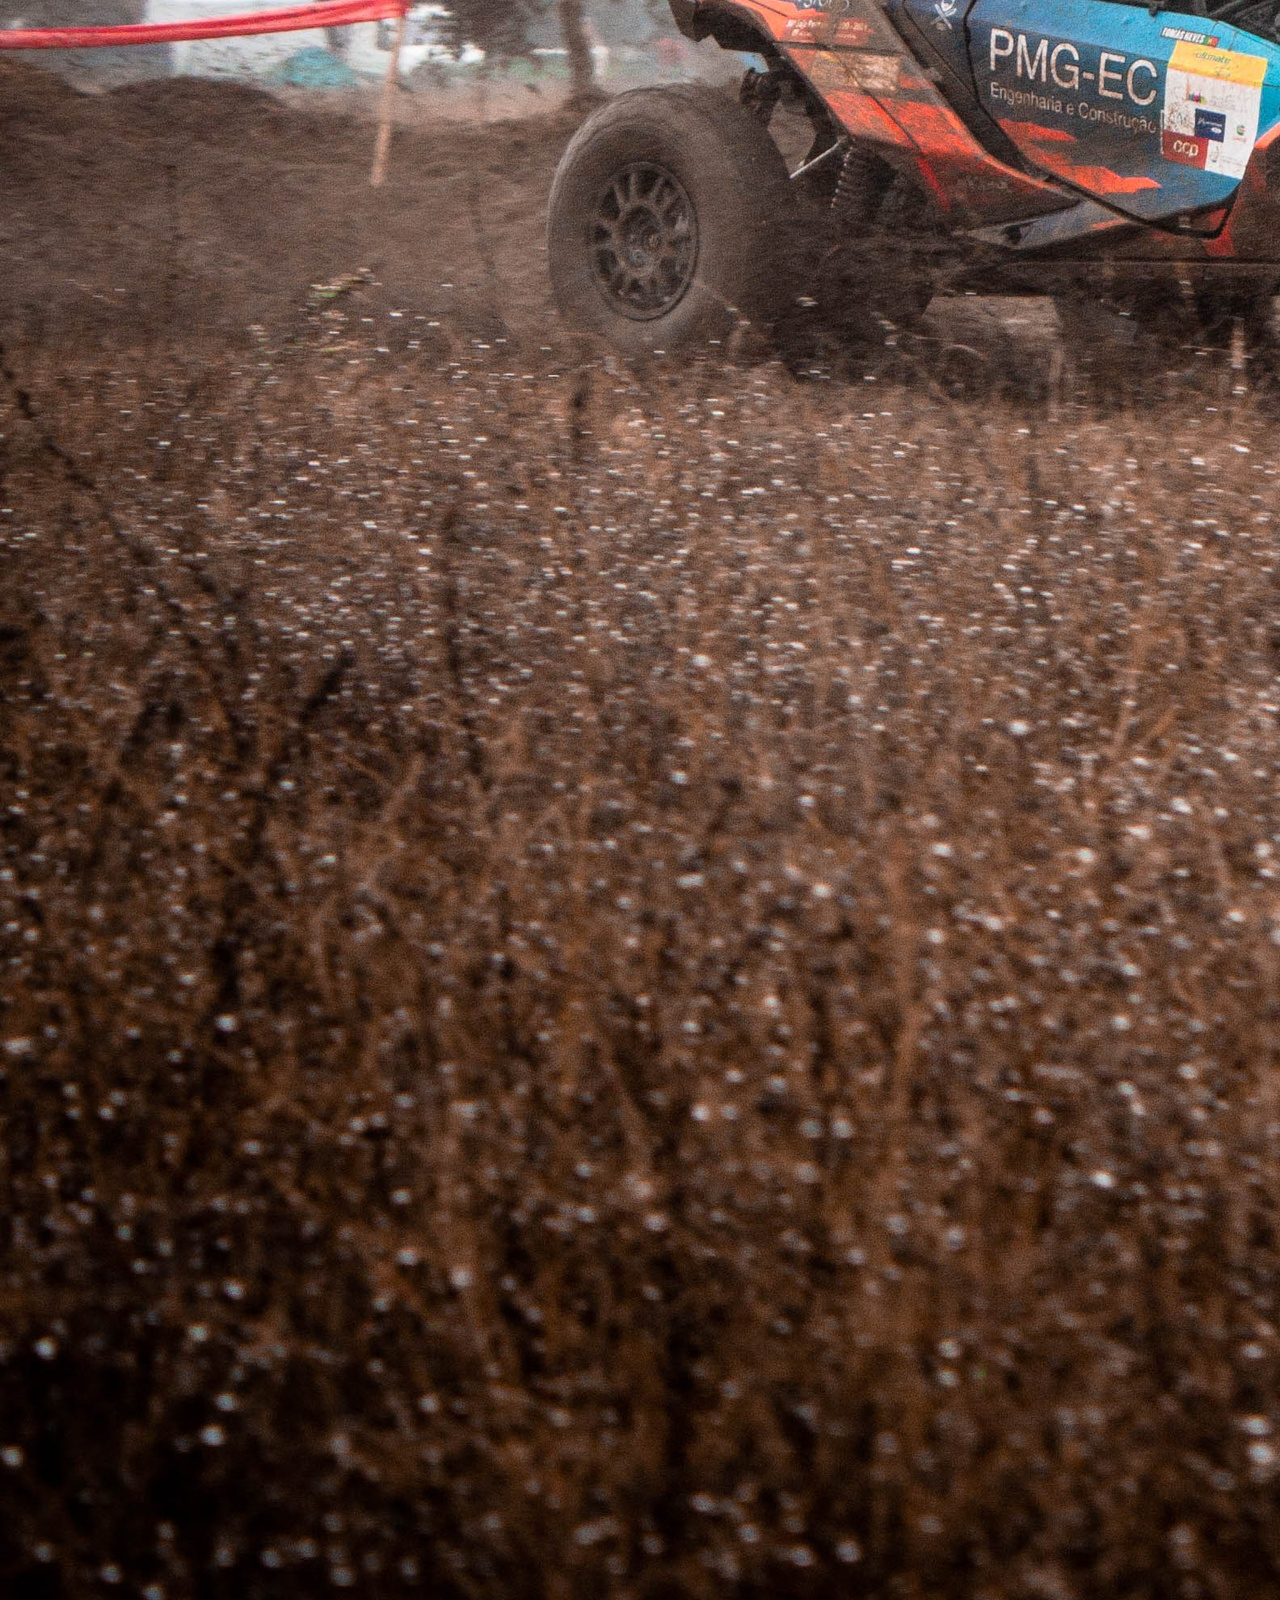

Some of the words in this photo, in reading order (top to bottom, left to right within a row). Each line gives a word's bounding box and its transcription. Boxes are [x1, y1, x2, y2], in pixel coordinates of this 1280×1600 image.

[989, 27, 1158, 106] PMG-EC
[990, 81, 1062, 113] Engenharia
[1066, 103, 1075, 115] e
[1078, 102, 1157, 134] Construção
